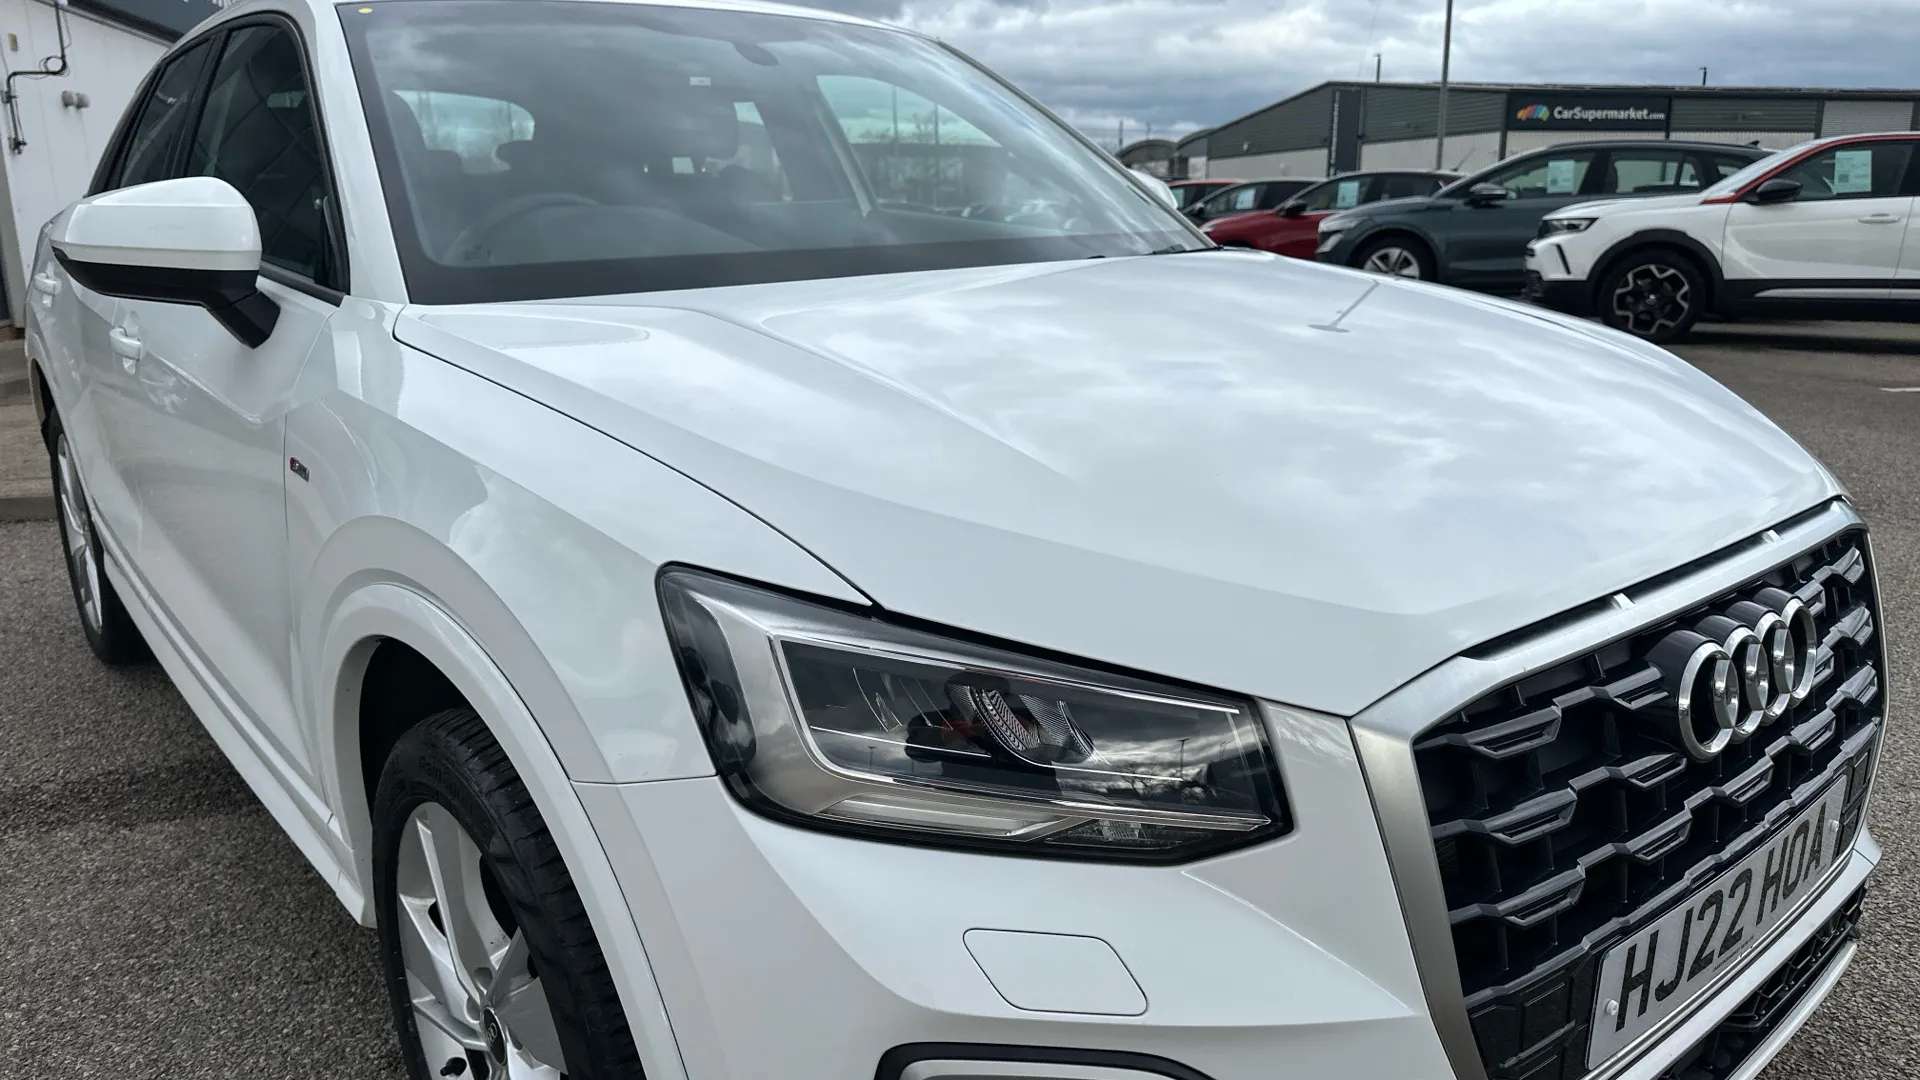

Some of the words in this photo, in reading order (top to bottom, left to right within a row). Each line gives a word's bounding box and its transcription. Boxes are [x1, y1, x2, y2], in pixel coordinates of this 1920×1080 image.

[1553, 106, 1665, 121] CarSupermarket.com
[1615, 868, 1753, 1033] HJ22
[1756, 801, 1827, 926] HOA
